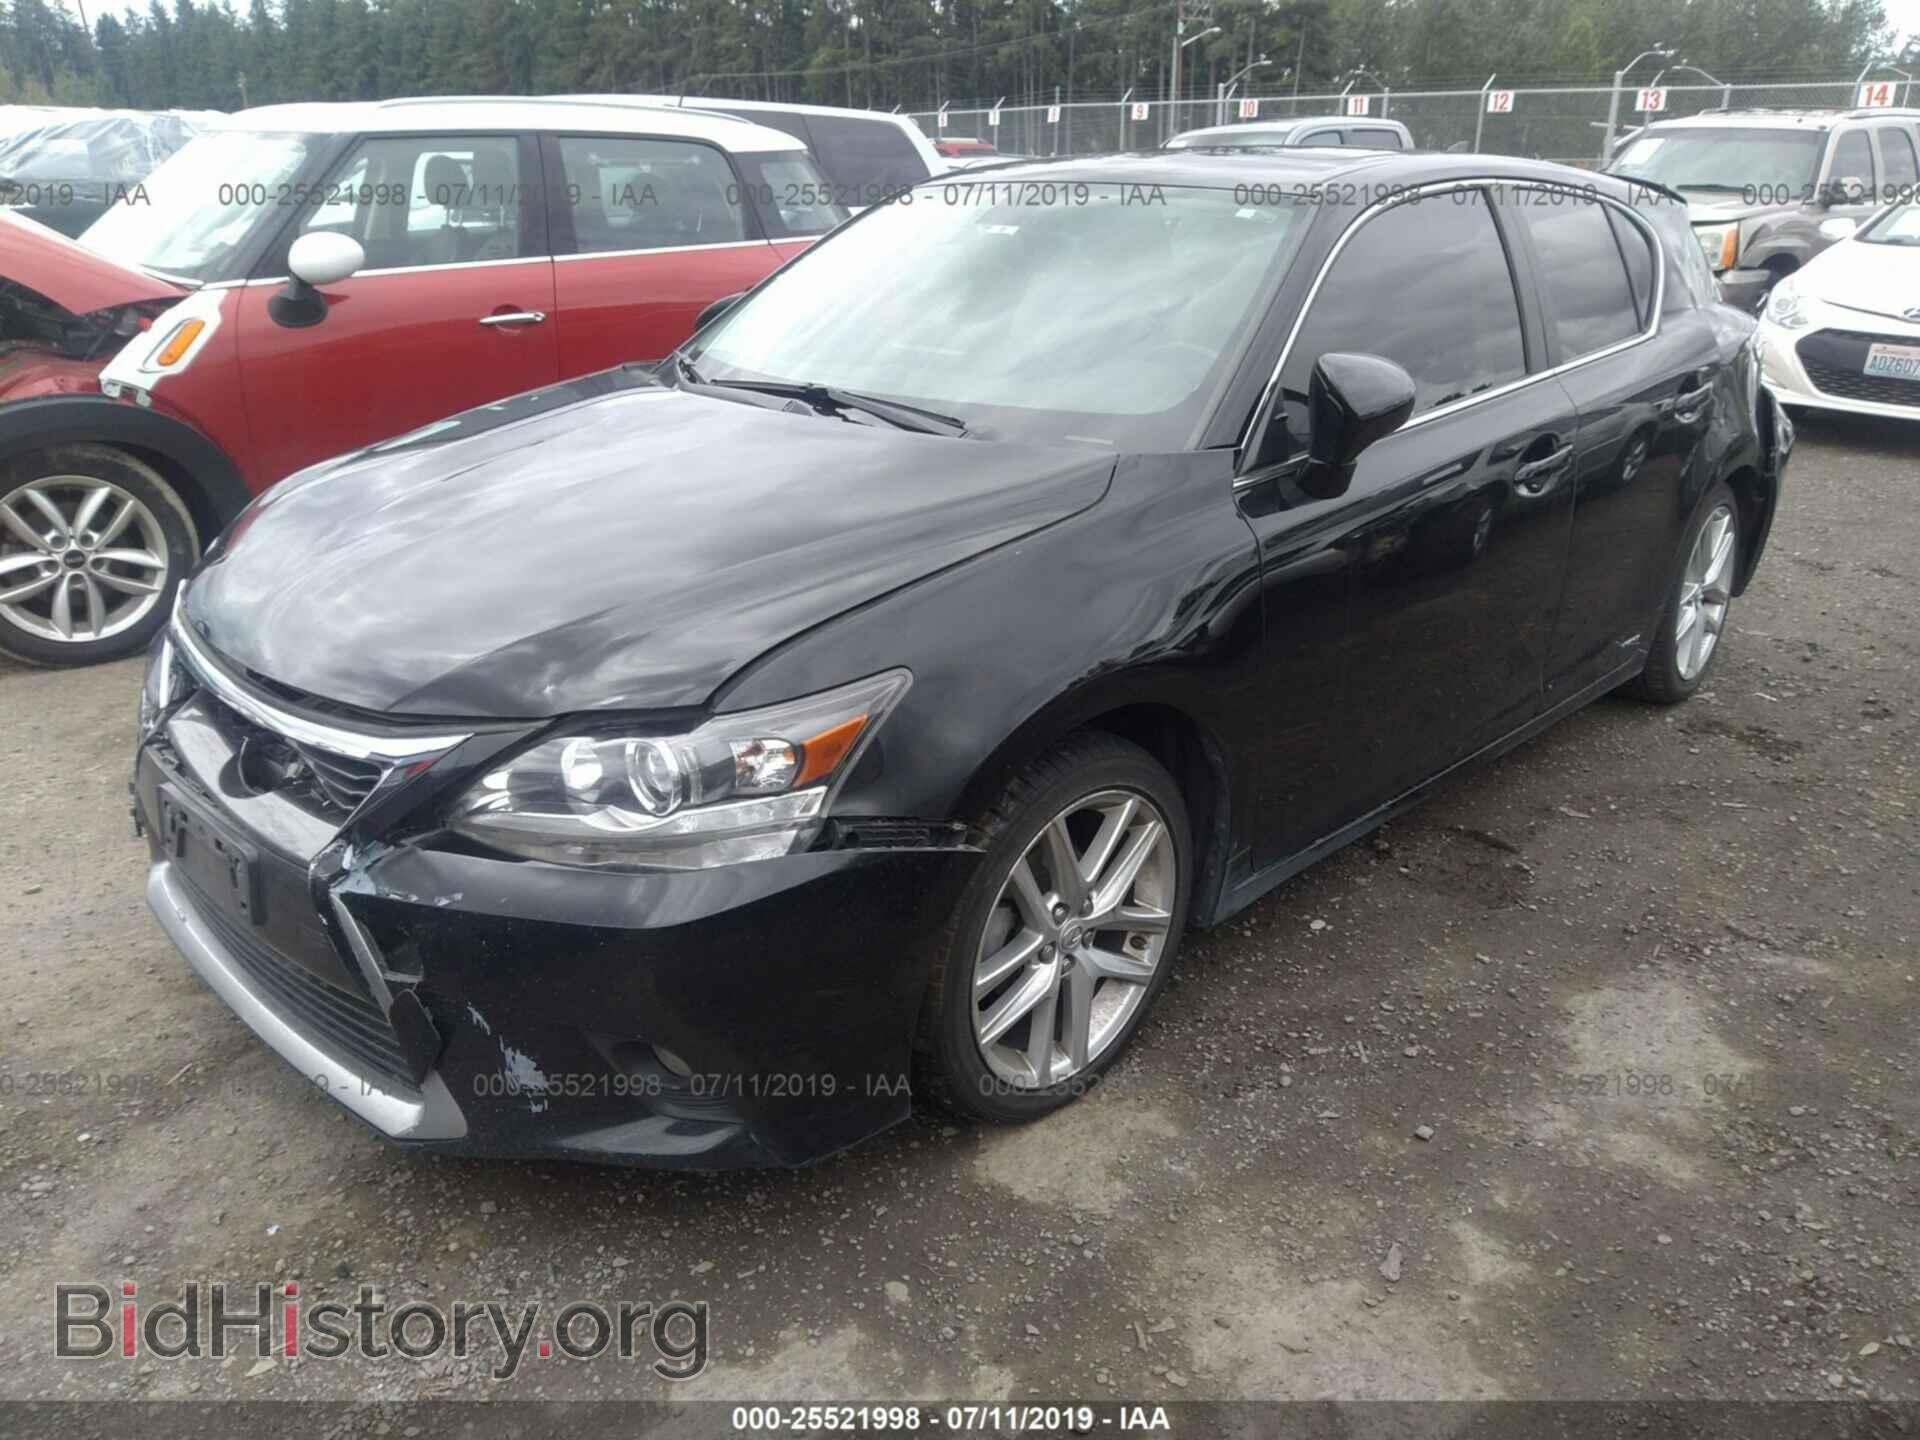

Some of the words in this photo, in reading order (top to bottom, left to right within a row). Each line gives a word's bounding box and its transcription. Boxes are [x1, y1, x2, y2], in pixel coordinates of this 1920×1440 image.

[1493, 93, 1509, 111] 12
[1641, 90, 1661, 110] 13
[1865, 83, 1893, 104] 14
[1136, 105, 1144, 119] 9
[1243, 99, 1255, 115] 10
[1353, 96, 1365, 113] 11
